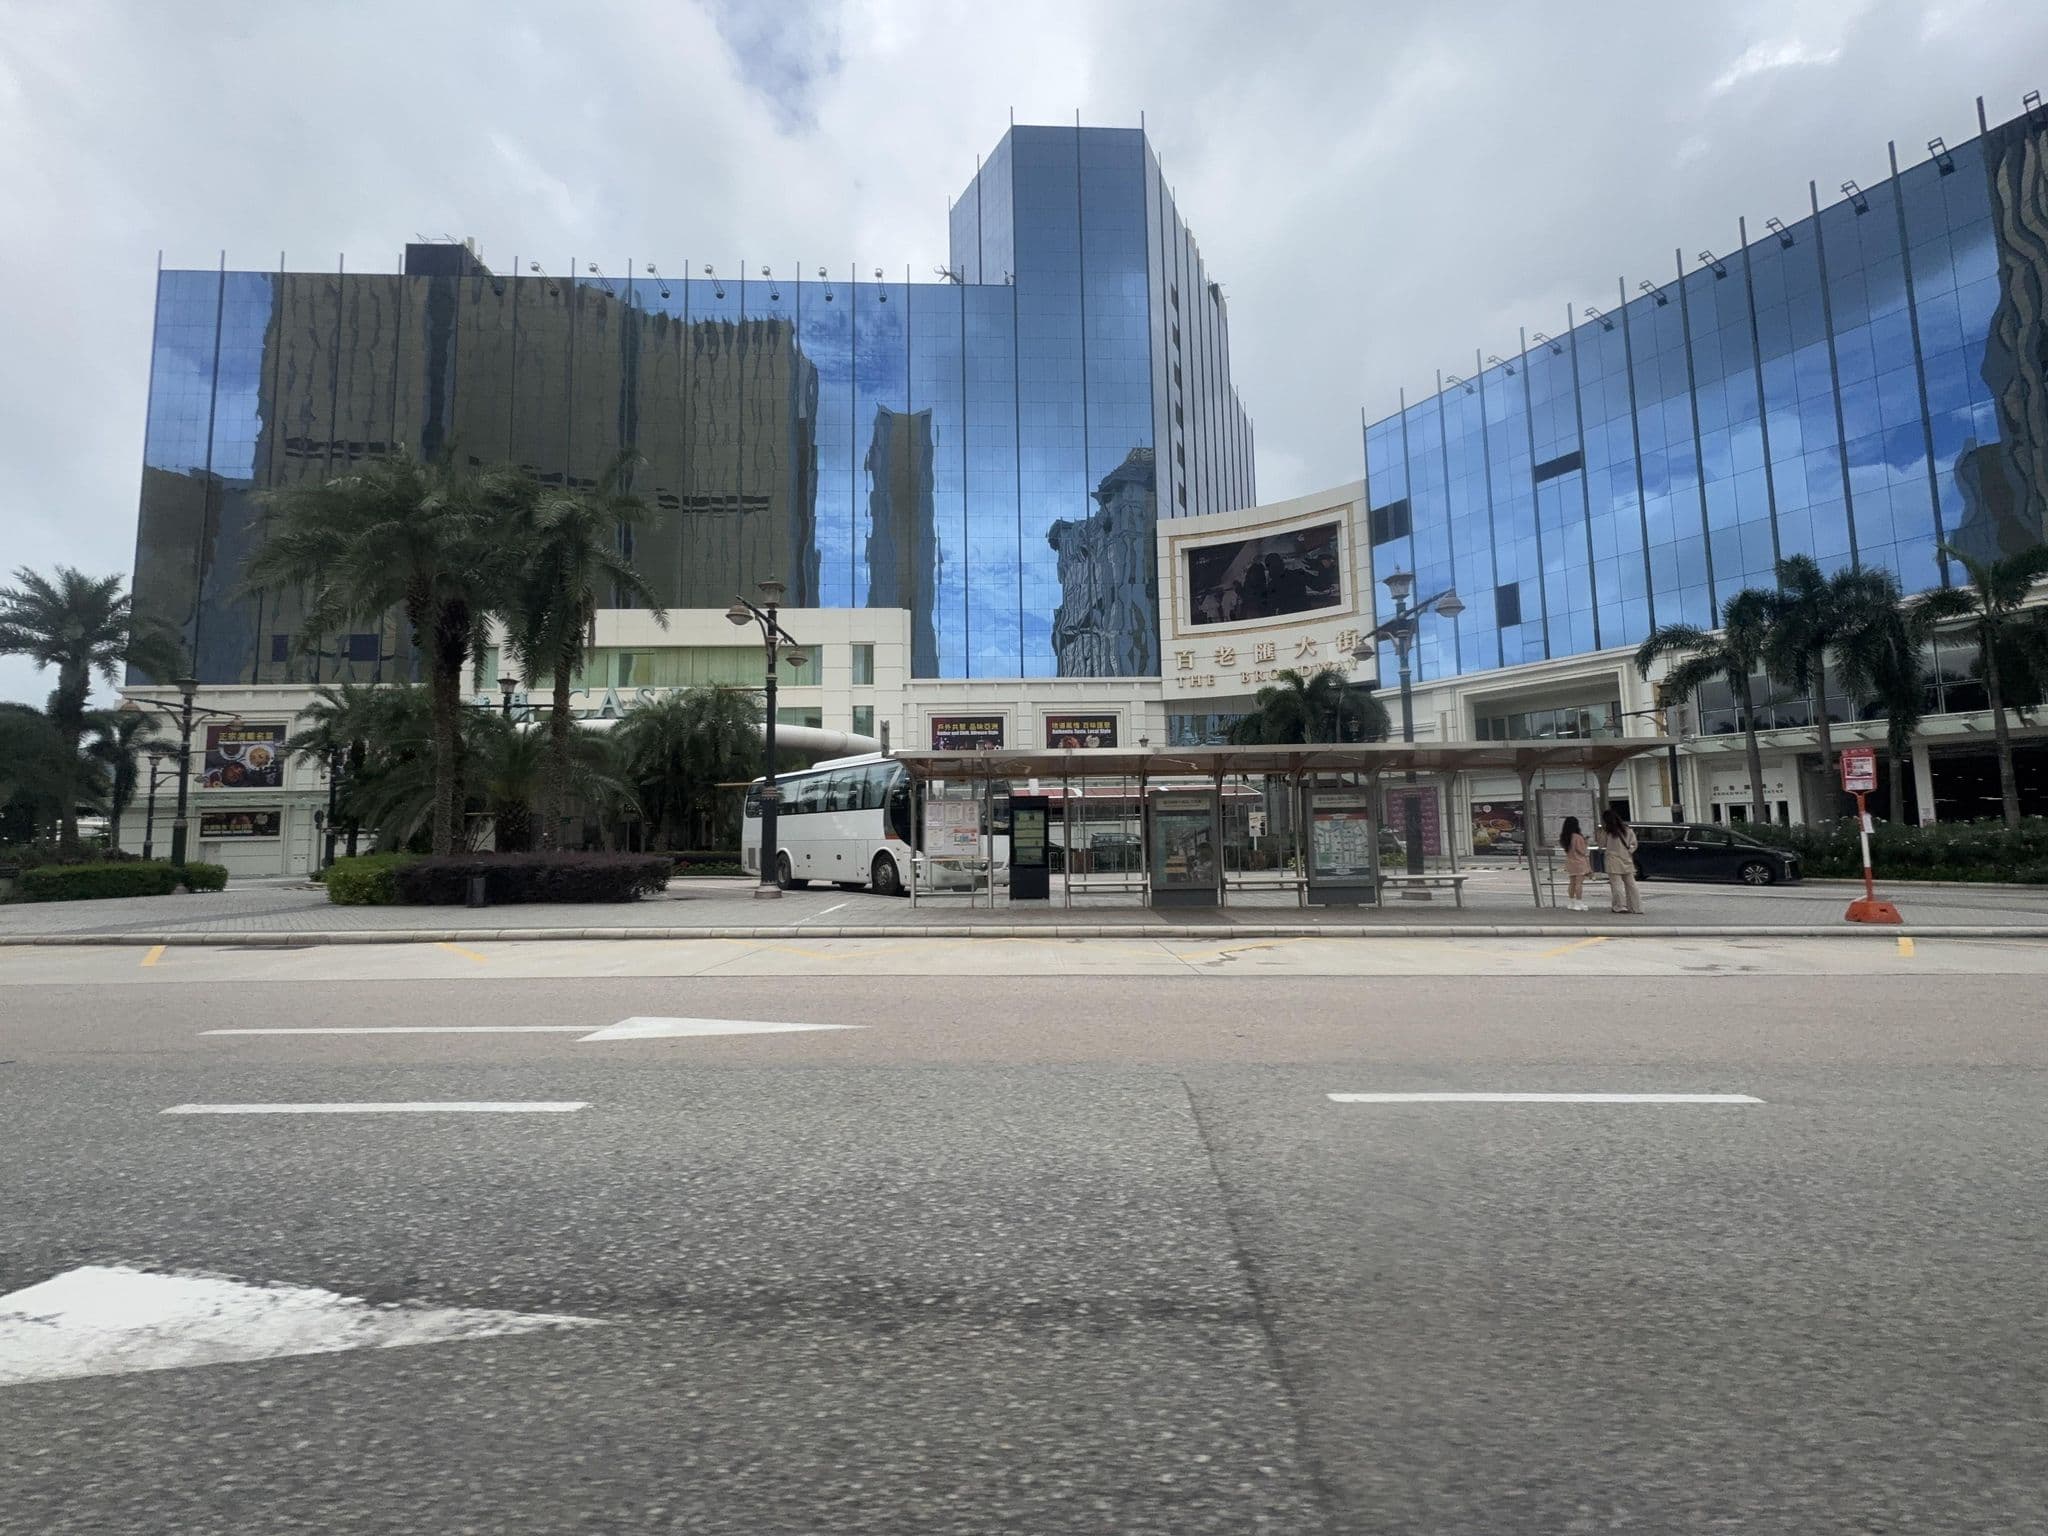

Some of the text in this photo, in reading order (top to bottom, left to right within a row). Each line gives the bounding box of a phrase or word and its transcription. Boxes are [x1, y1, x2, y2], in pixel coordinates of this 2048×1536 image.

[1175, 629, 1362, 670] 百老匯大街
[1177, 656, 1358, 689] THE BRODWY
